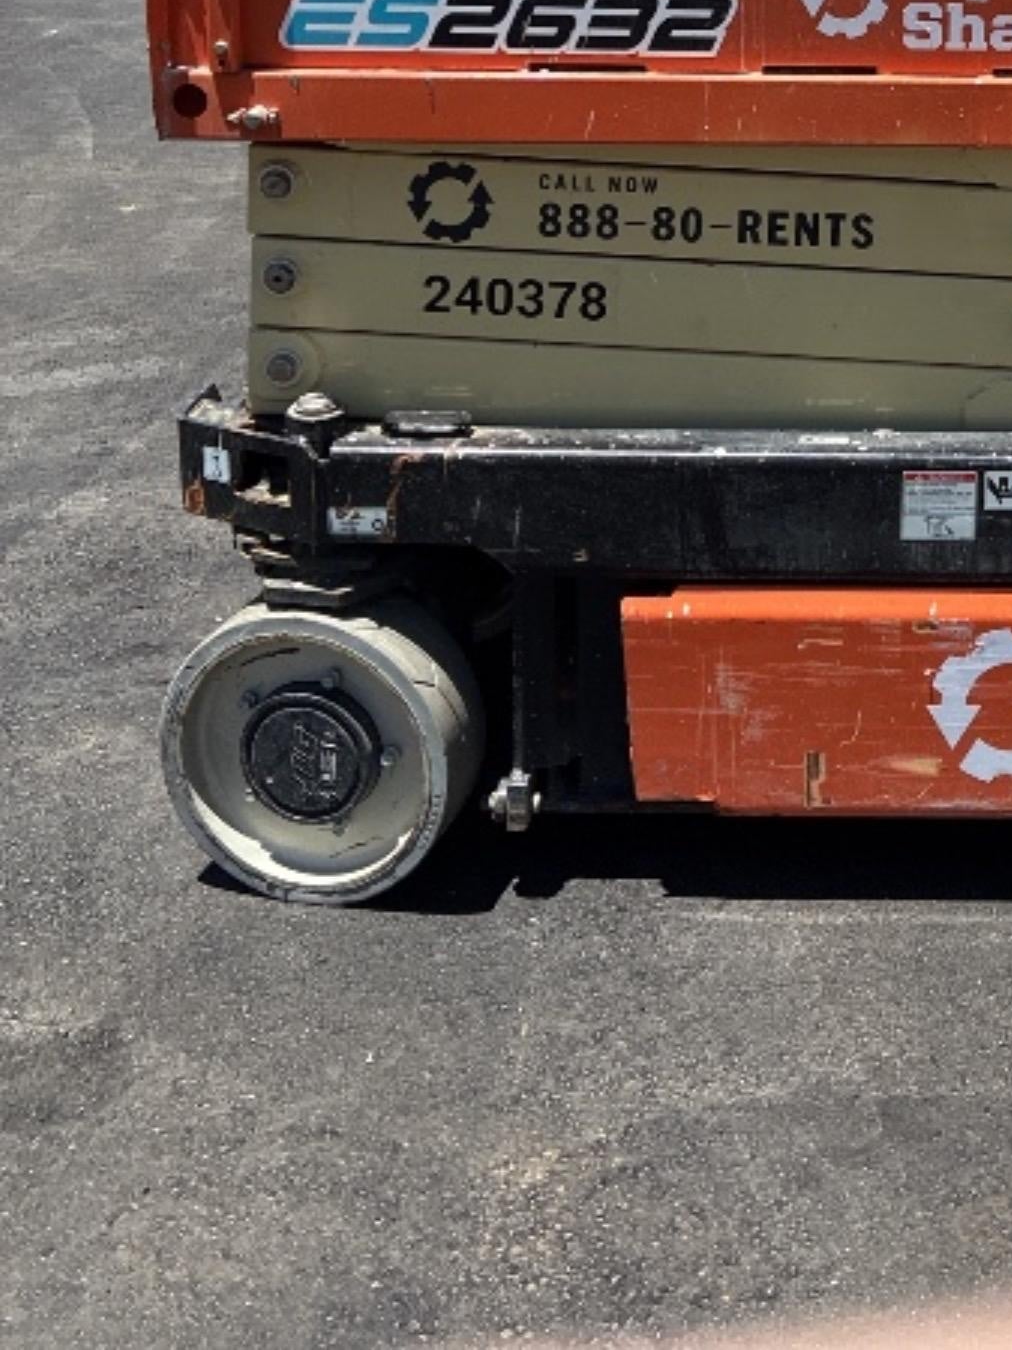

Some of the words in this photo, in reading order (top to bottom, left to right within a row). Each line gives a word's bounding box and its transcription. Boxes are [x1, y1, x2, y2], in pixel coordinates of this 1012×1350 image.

[538, 173, 595, 193] CALL
[608, 177, 659, 194] NOW
[538, 203, 875, 249] 888-80-RENTS
[423, 275, 608, 321] 240378
